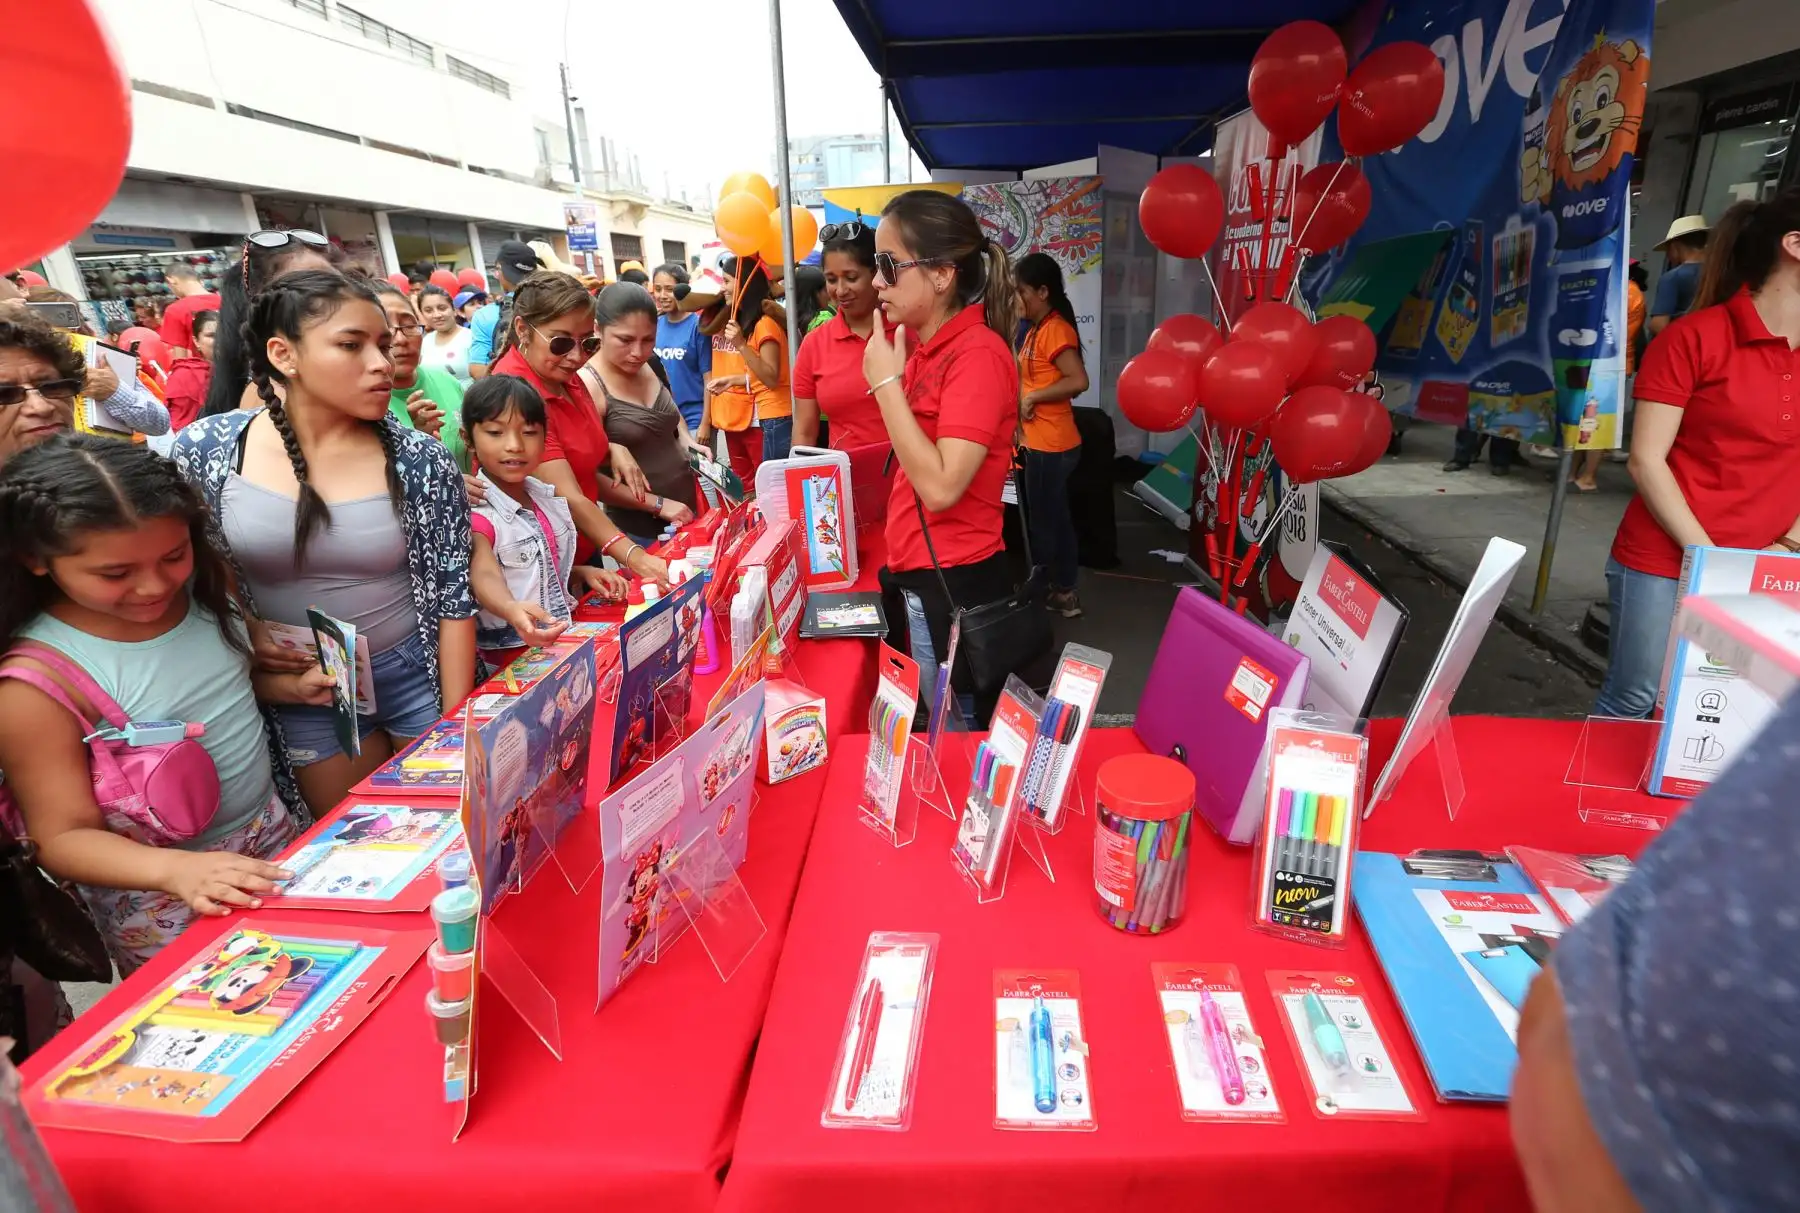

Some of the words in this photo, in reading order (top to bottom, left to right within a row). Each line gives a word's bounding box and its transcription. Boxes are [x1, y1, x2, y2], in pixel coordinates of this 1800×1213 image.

[1715, 106, 1744, 123] pierre
[1745, 98, 1779, 115] cardin
[1323, 574, 1368, 626] FABER-CASTELL
[1300, 595, 1318, 621] Pioner
[1318, 612, 1347, 650] Universal
[1275, 886, 1319, 905] neon
[1452, 897, 1535, 911] FABER-CASTELL
[1003, 988, 1069, 998] FABER-CASTELL
[1164, 981, 1233, 992] FABER-CASTELL
[1288, 986, 1348, 996] FABER-CASTELL
[270, 981, 369, 1069] FABER-CASTELL
